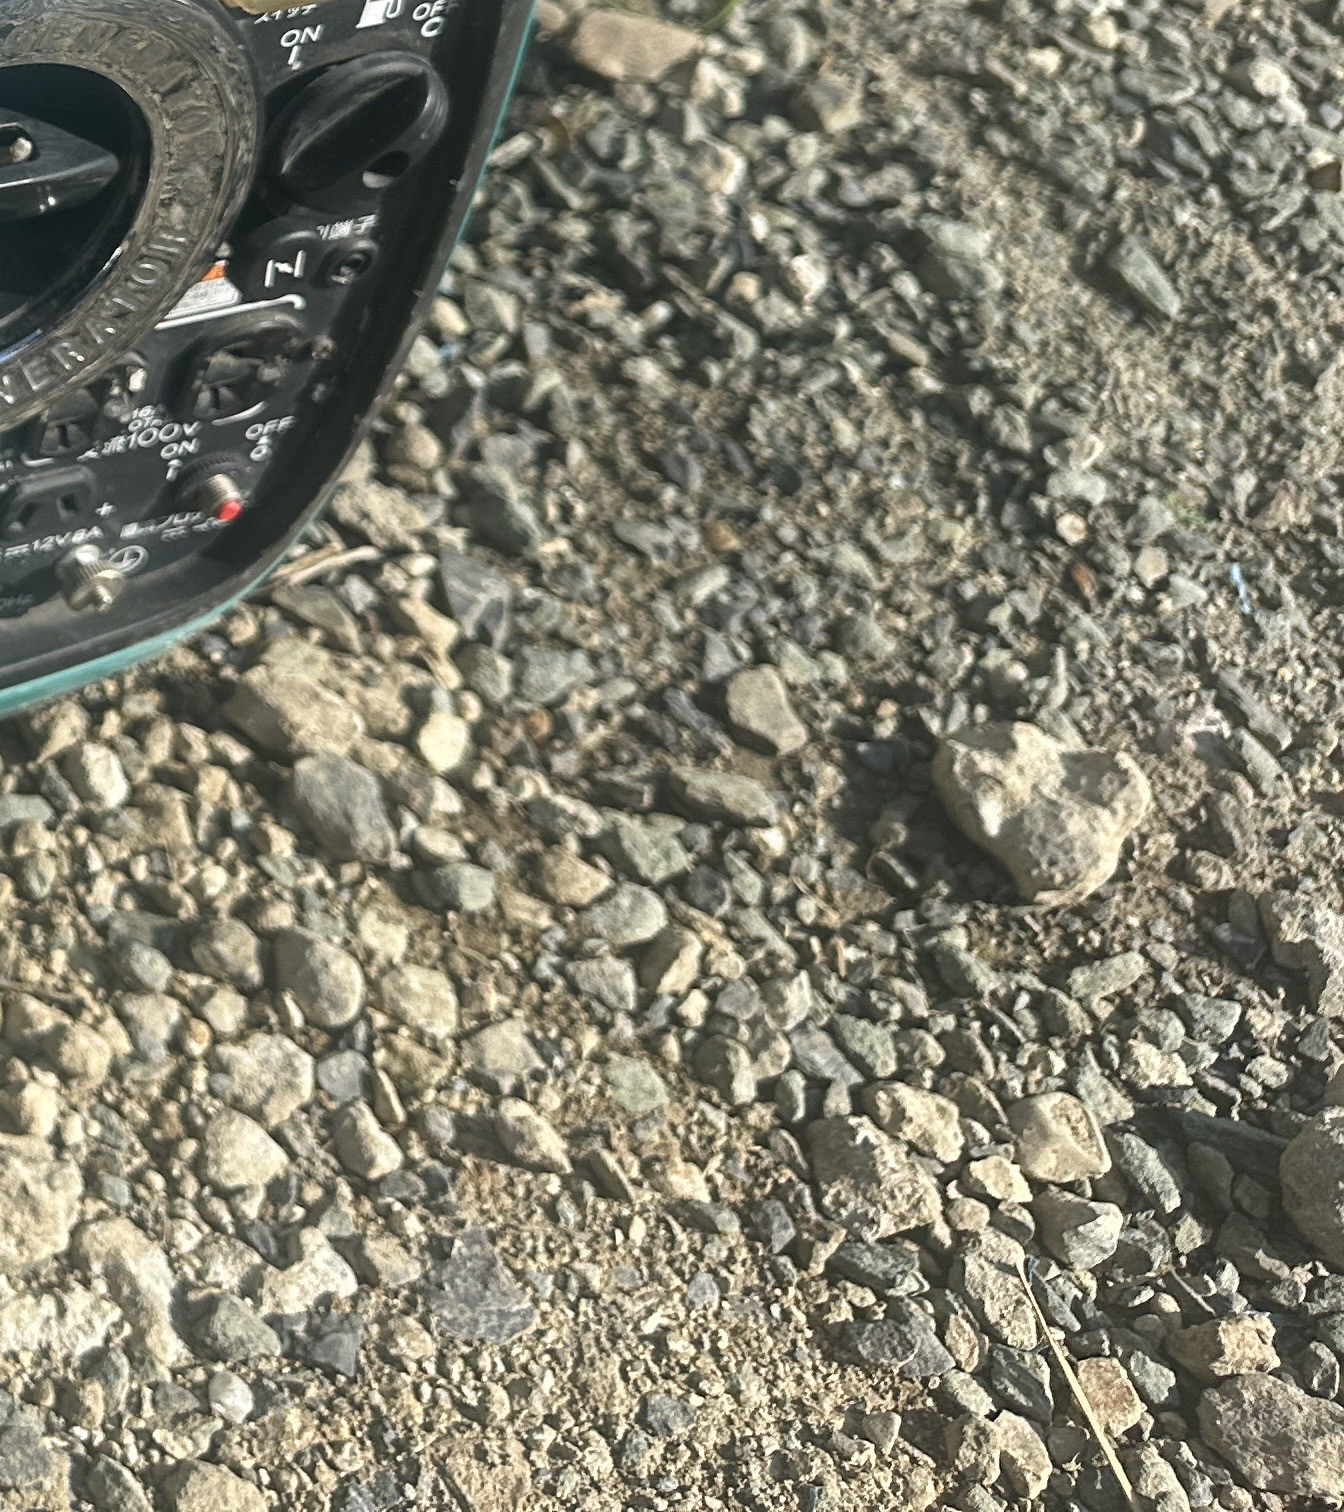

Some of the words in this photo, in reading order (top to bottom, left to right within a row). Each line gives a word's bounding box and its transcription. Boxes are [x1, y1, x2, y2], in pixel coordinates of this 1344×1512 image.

[280, 24, 324, 48] ON
[160, 438, 200, 458] ON
[245, 416, 296, 441] OFF
